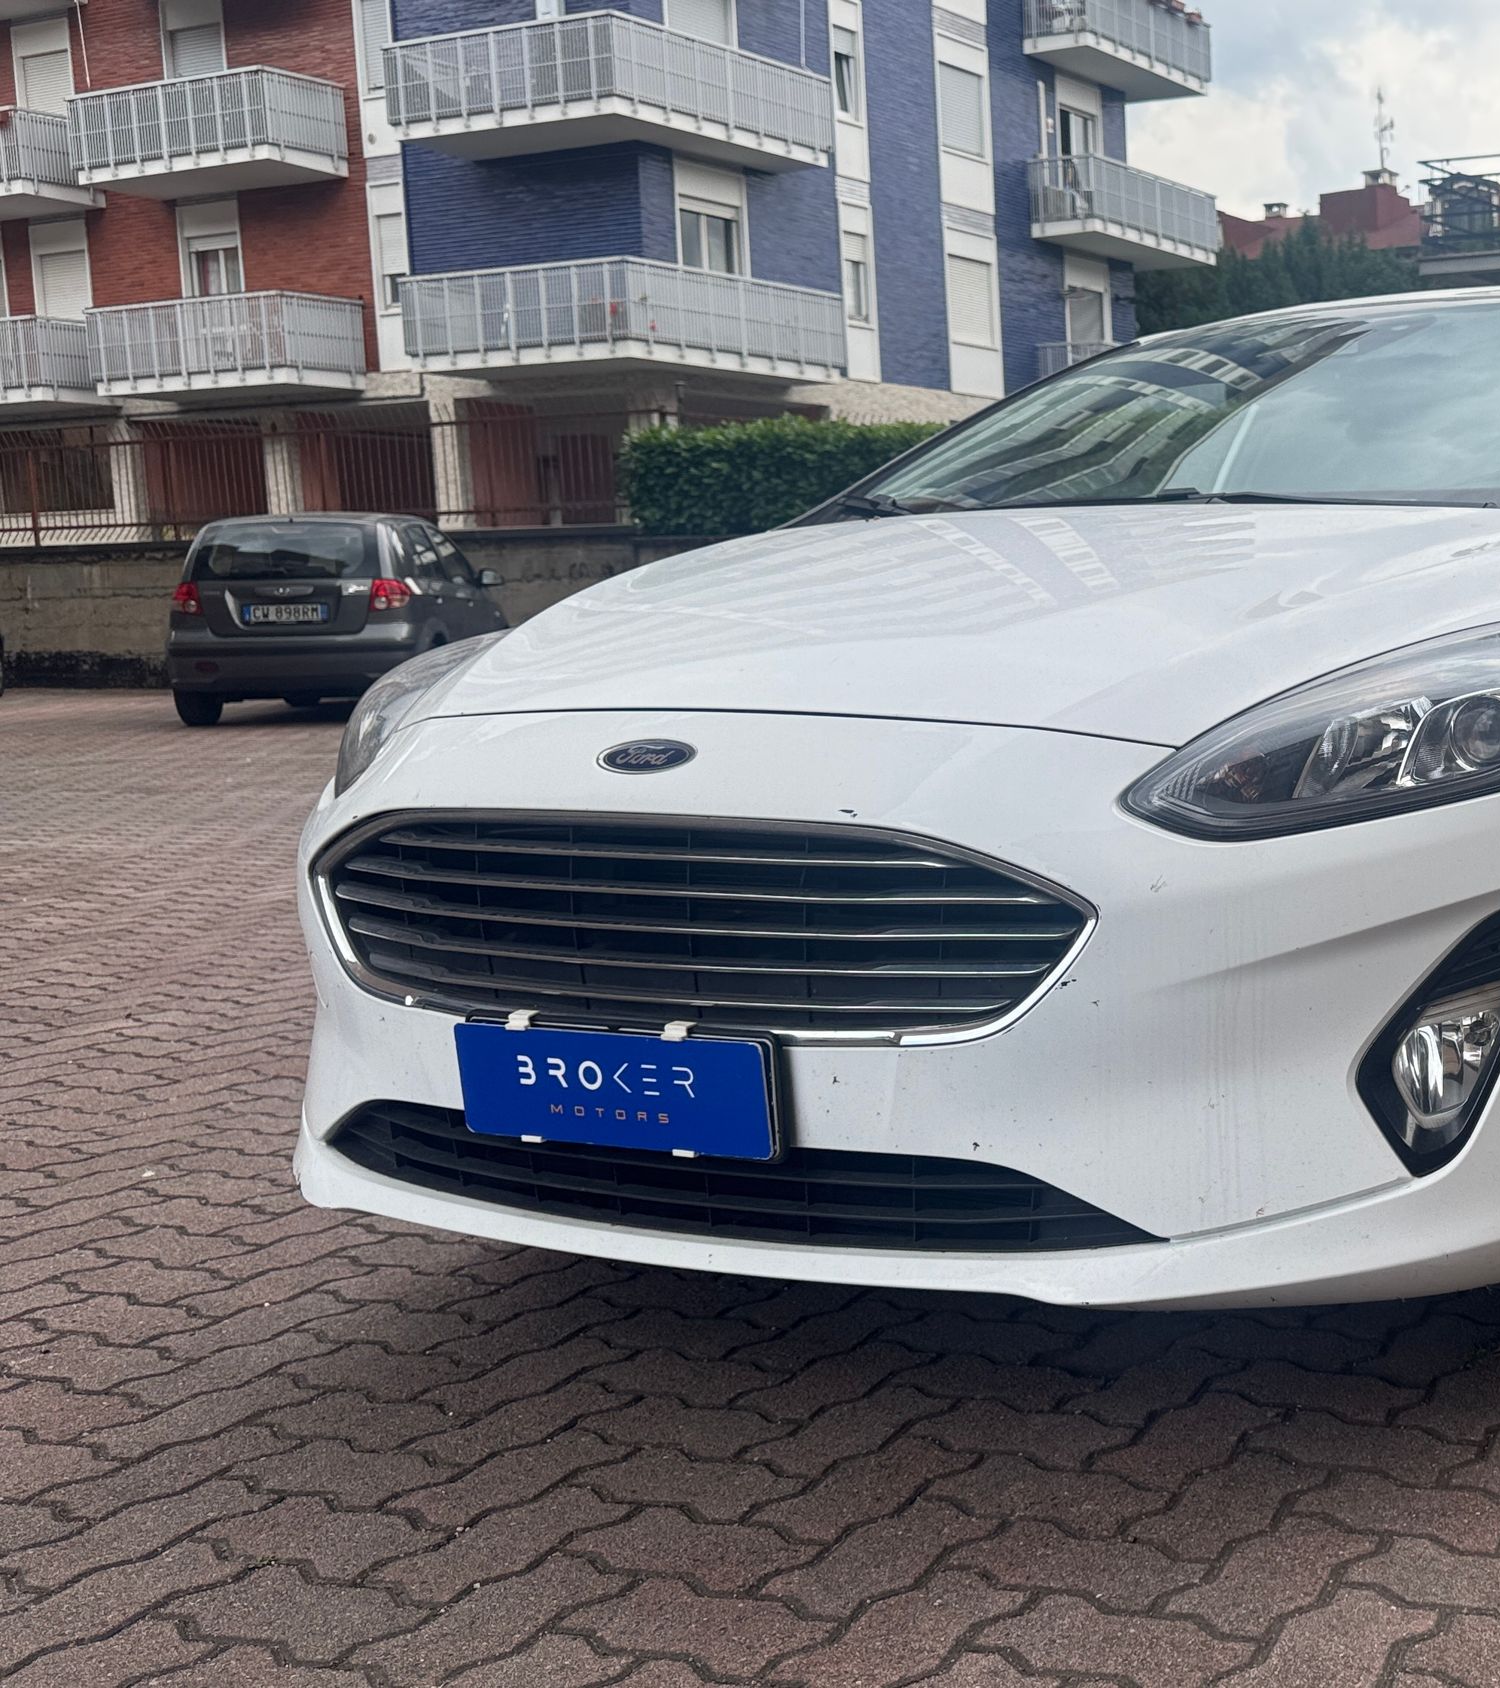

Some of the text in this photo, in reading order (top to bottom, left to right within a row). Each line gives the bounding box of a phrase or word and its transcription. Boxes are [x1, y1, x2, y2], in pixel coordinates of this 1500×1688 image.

[252, 606, 319, 619] CW 898RM
[616, 744, 675, 765] Ford
[516, 1055, 696, 1098] BROKER
[550, 1103, 670, 1124] MOTORS
